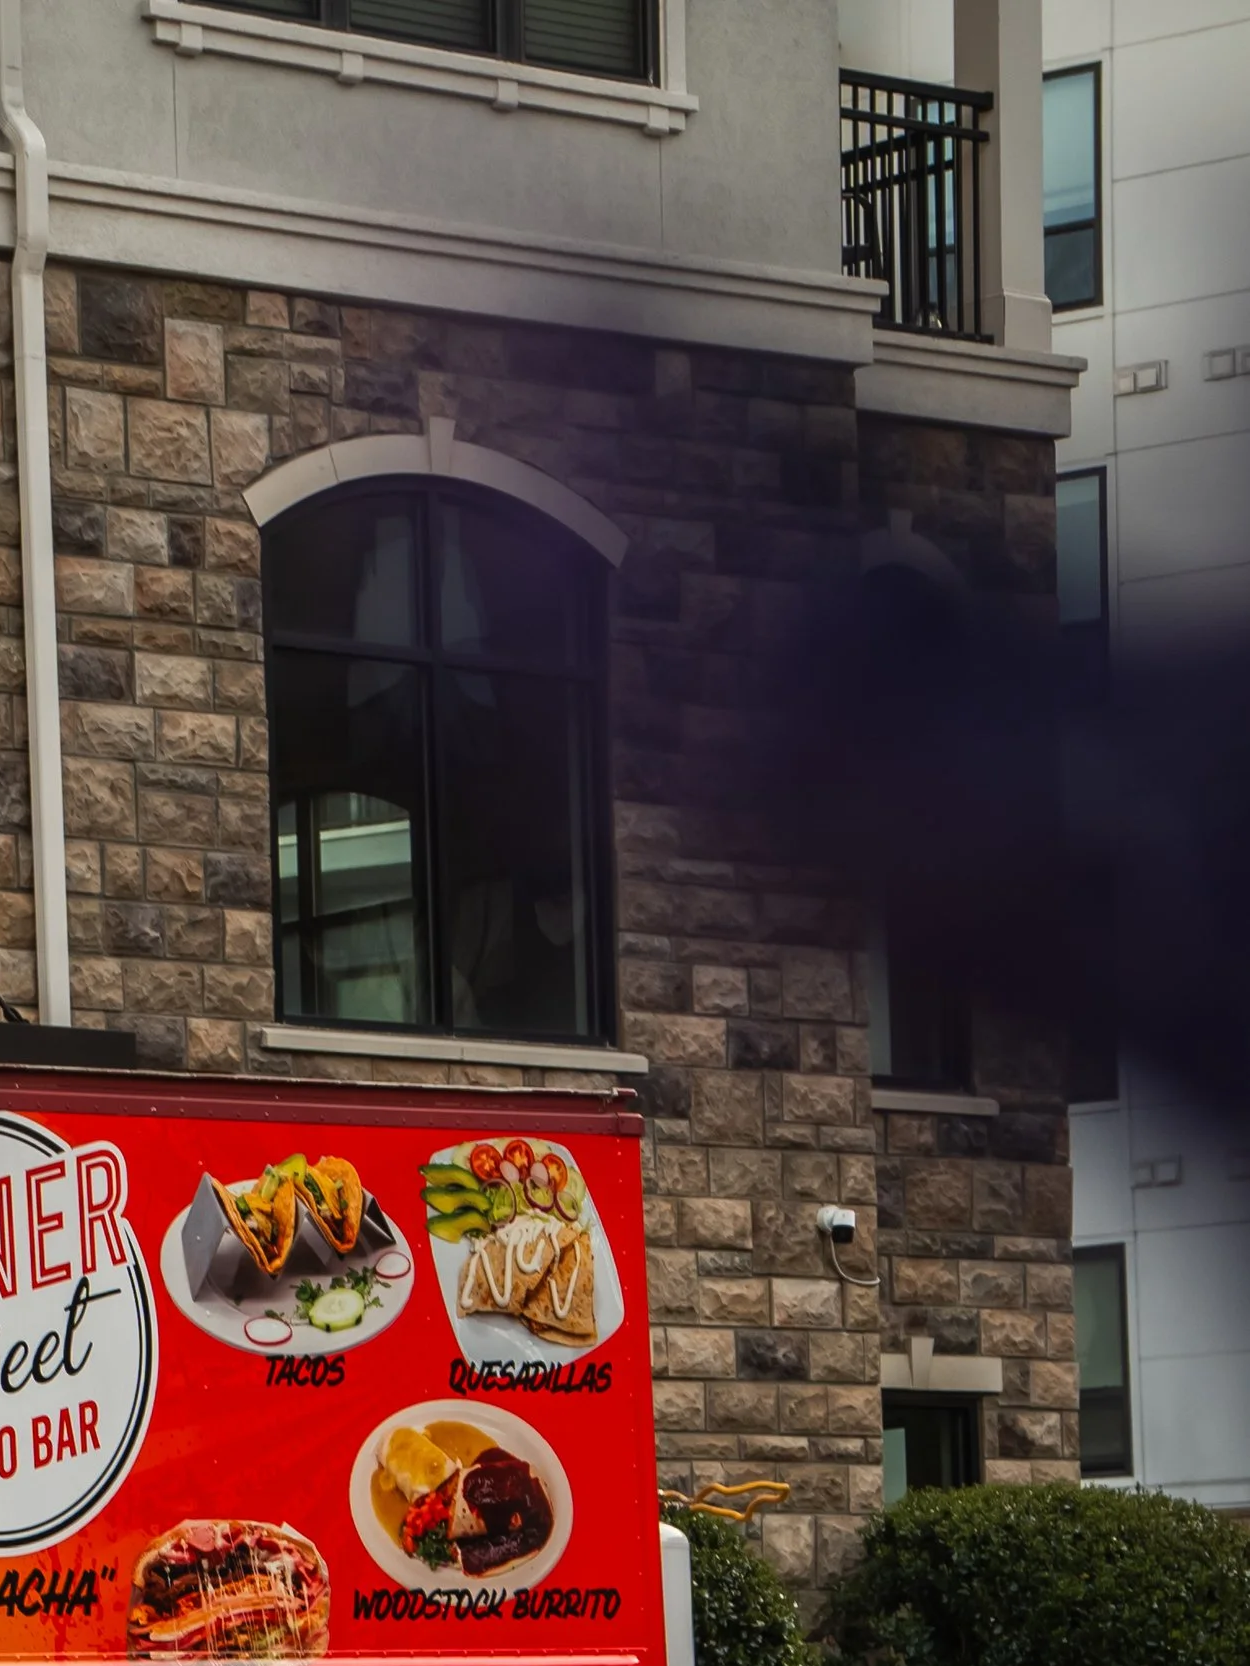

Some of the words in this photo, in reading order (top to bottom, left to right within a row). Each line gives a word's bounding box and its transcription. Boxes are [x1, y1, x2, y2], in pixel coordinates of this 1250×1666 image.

[265, 1355, 346, 1387] TACOS
[449, 1358, 613, 1394] QUESADILLAS
[31, 1400, 101, 1470] BAR
[353, 1588, 507, 1621] WOODSTOCK
[513, 1588, 621, 1622] BURRITO
